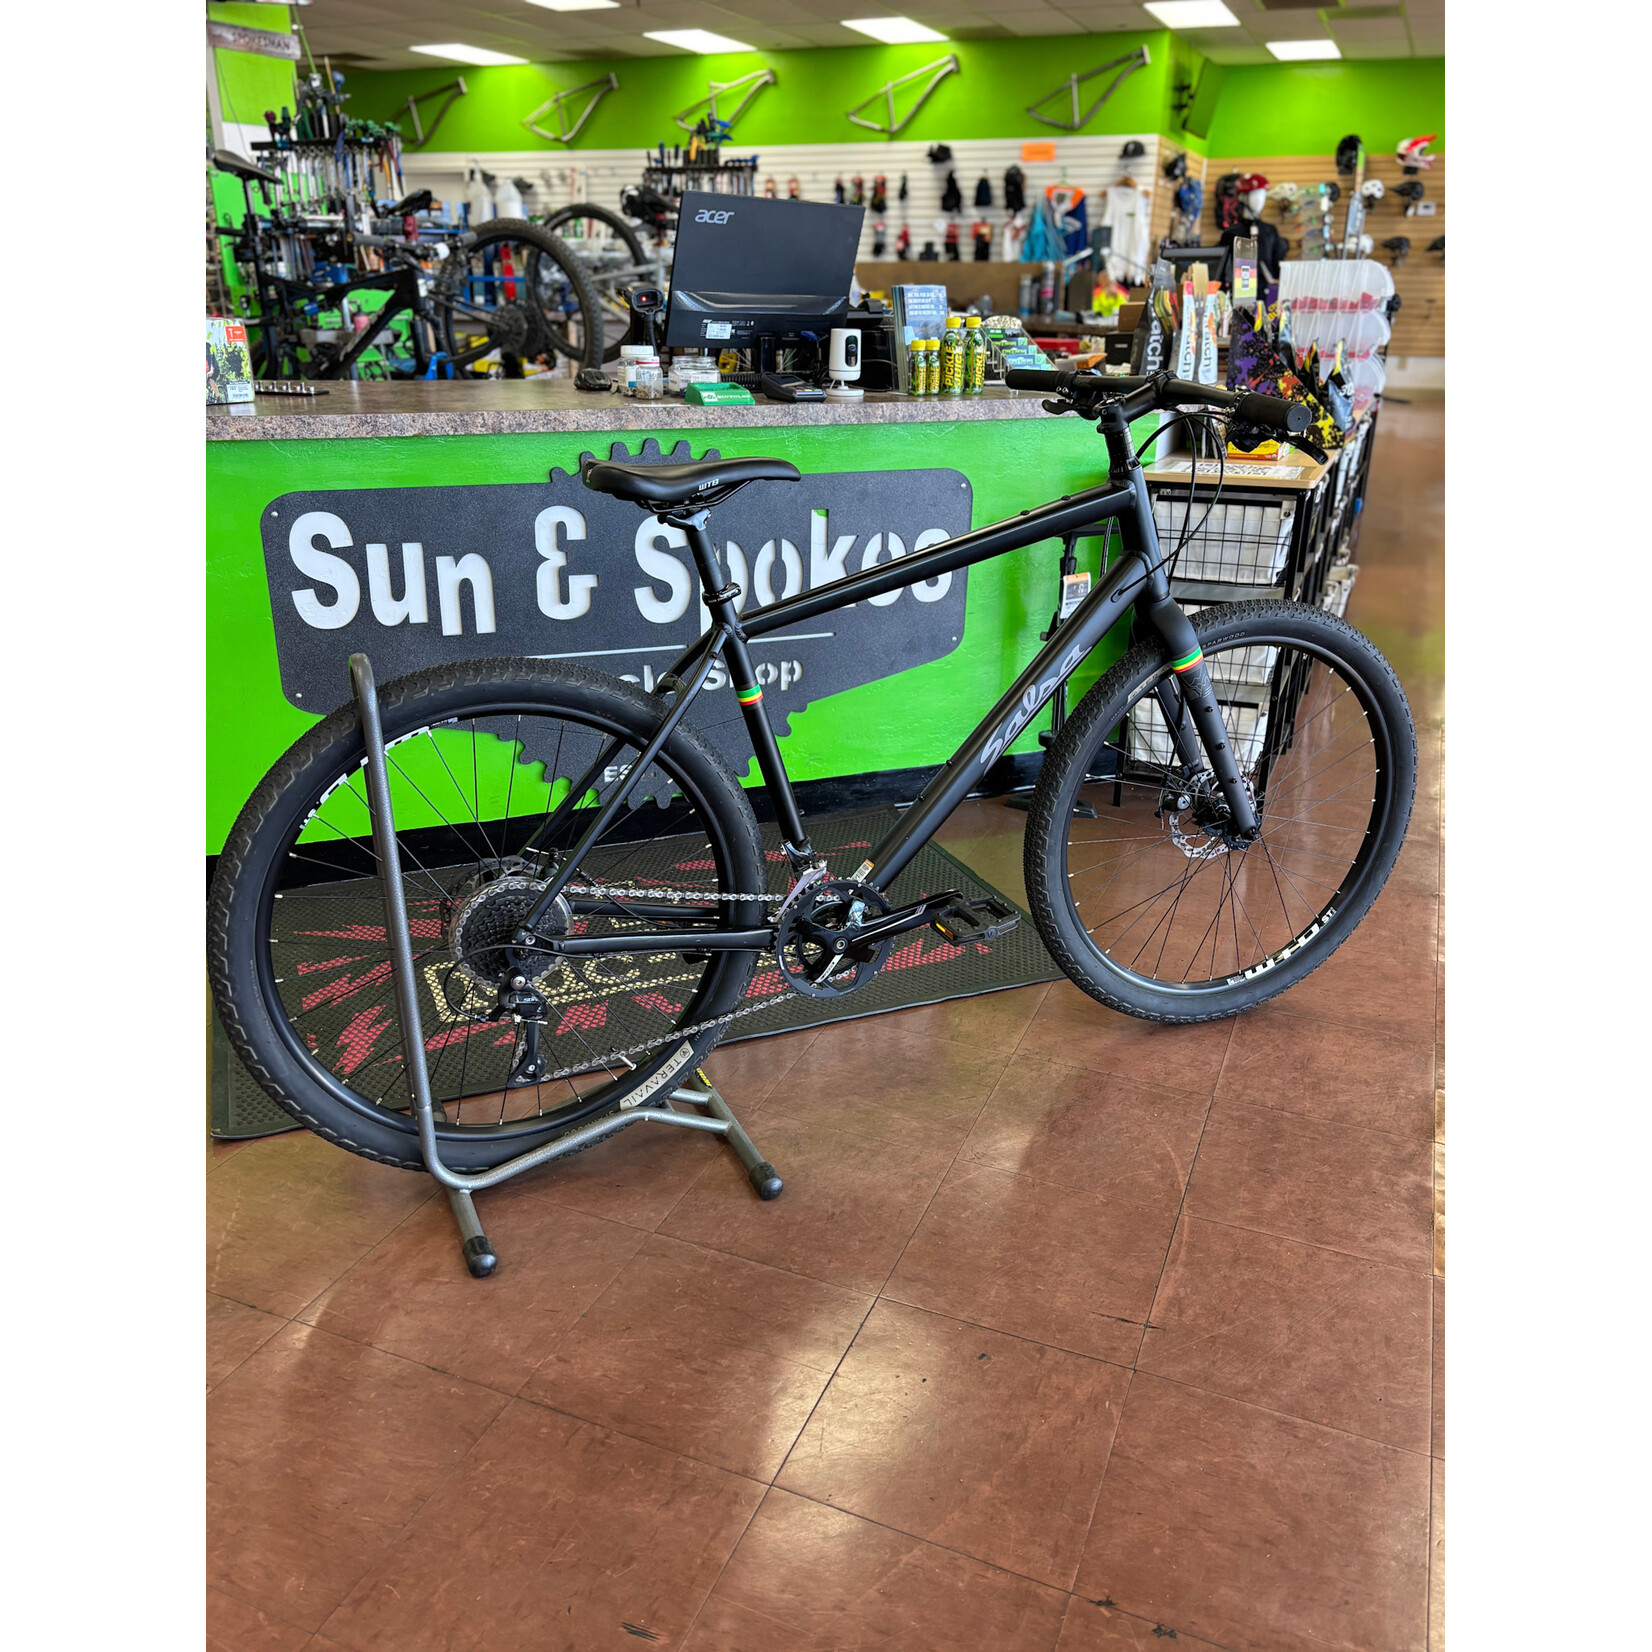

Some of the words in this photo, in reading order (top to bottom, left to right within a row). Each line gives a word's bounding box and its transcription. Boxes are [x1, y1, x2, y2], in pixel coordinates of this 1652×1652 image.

[695, 209, 734, 225] acer
[945, 346, 955, 386] PICKLE
[954, 349, 963, 386] JUICE
[698, 478, 720, 491] WTB
[289, 510, 497, 638] Sun
[533, 505, 599, 621] &
[634, 508, 952, 637] Spokes
[1202, 631, 1246, 649] SPARWOOD
[702, 659, 803, 691] Sop
[980, 644, 1093, 774] Salsa
[622, 1058, 682, 1106] TERAVAIL
